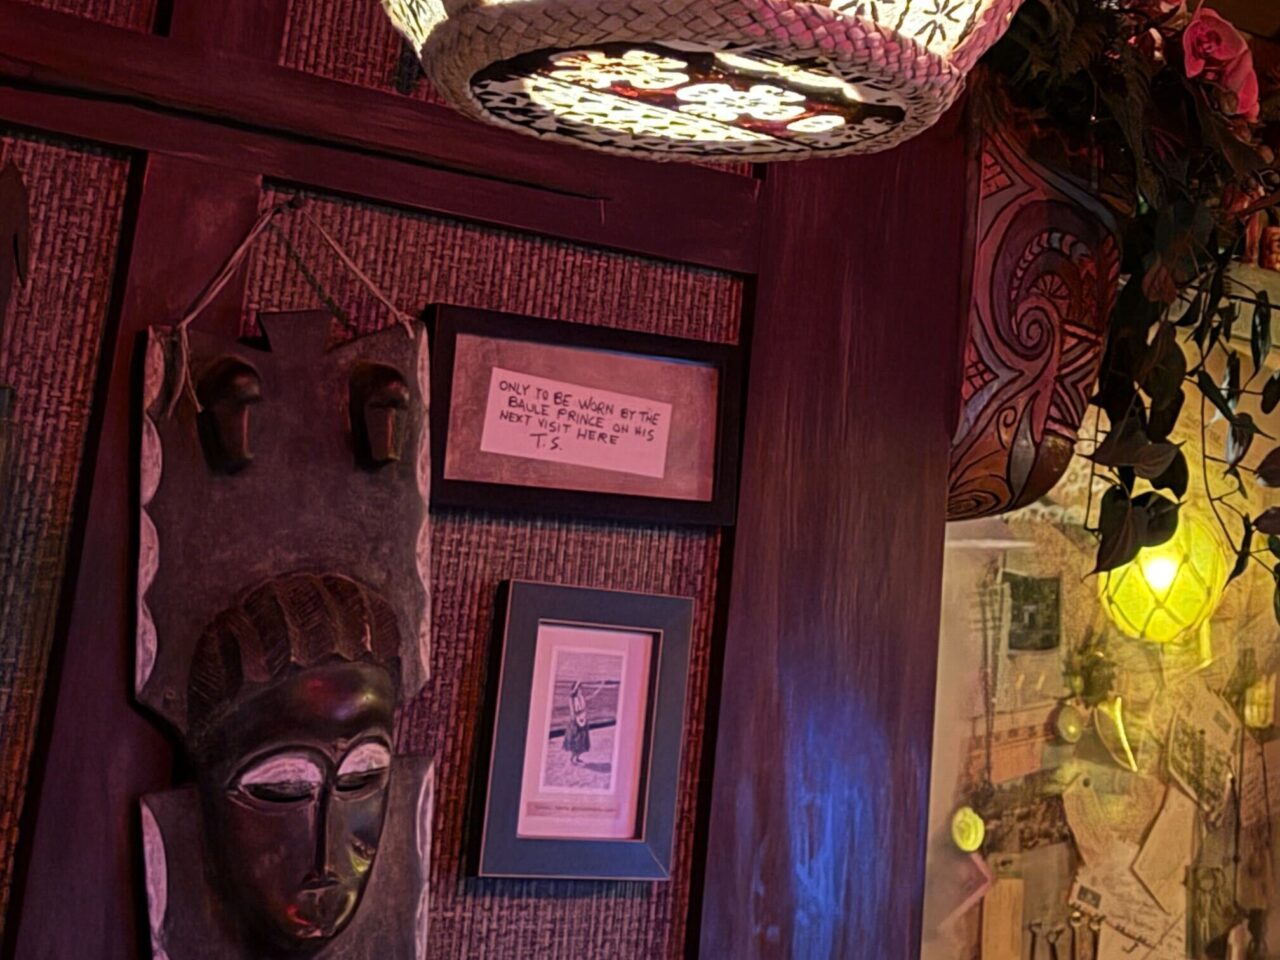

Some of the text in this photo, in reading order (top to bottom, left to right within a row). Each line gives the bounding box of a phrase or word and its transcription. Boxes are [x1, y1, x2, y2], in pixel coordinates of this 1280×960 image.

[499, 380, 661, 426] ONLY TO BE WORN BY THE
[508, 395, 655, 442] BAULE PRINCE ON HIS
[499, 410, 620, 445] NEXT VISIT HERE
